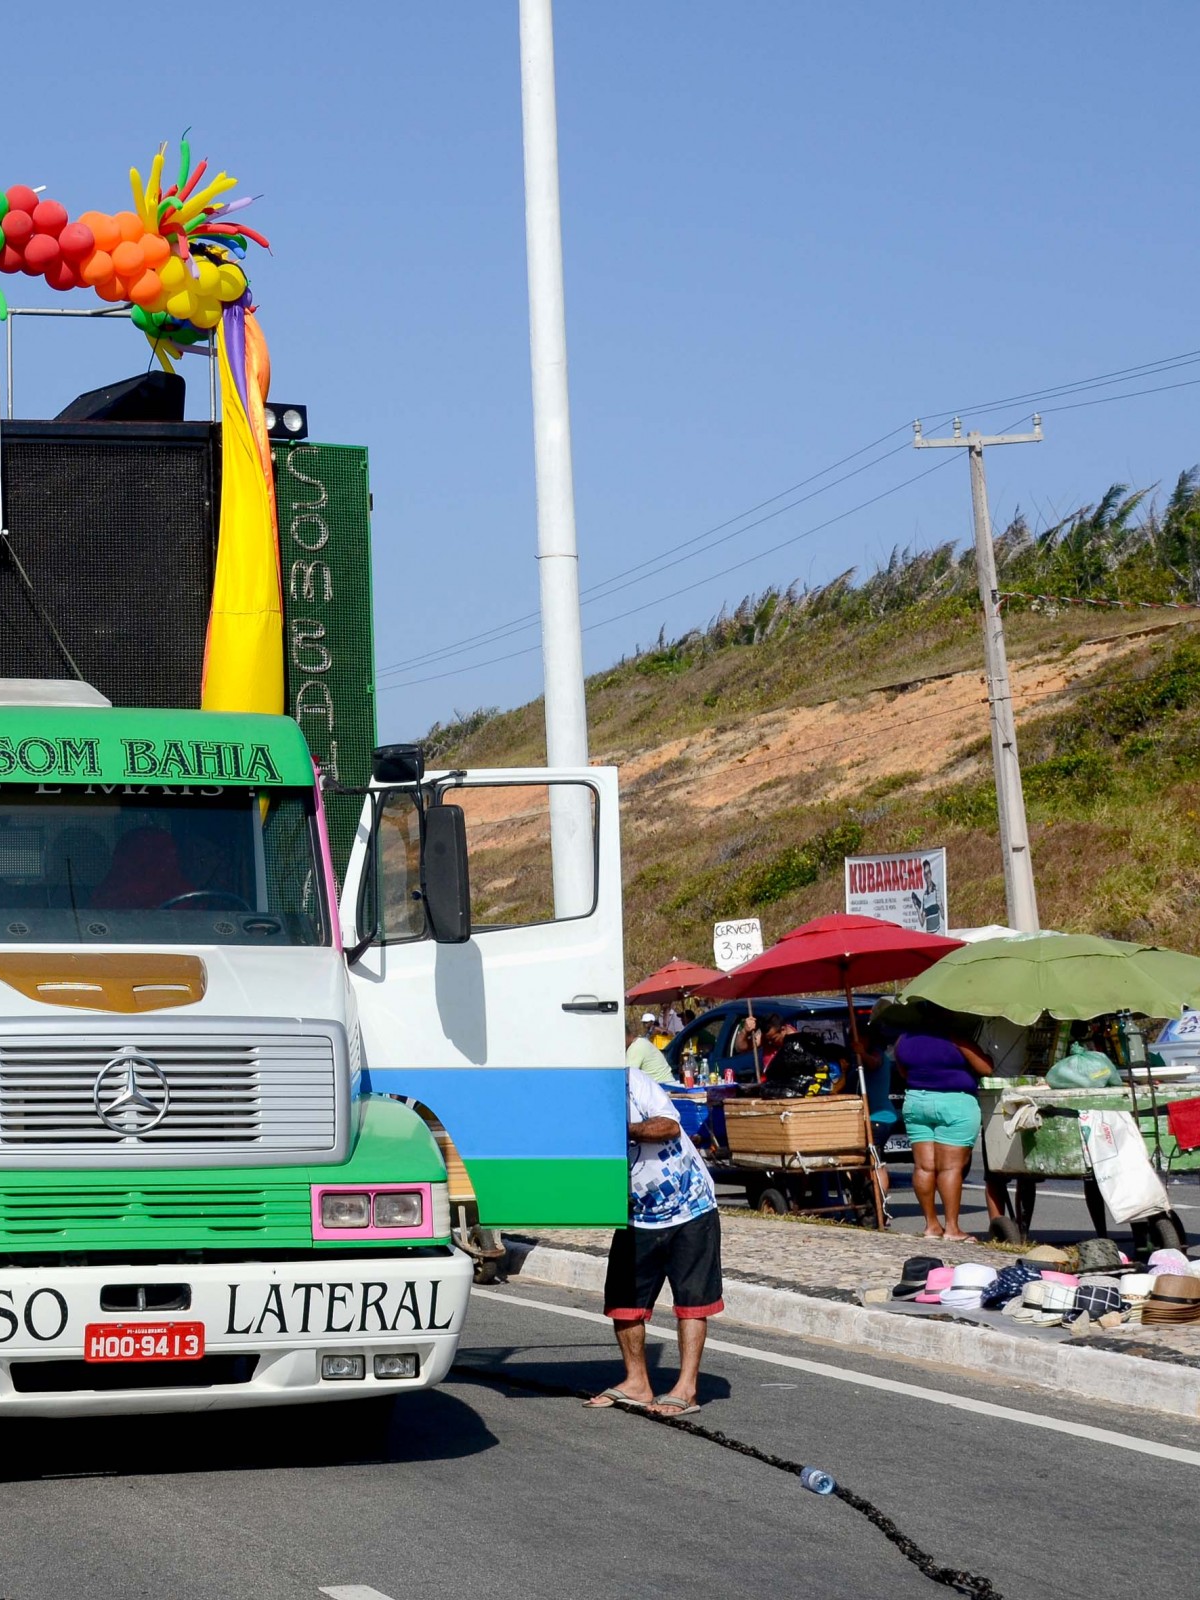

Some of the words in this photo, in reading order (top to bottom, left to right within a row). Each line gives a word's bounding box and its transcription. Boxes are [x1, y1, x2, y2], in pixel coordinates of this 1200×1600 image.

[286, 446, 333, 602] SOM
[120, 738, 284, 783] BAHIA
[849, 858, 924, 894] KUBANACAN
[715, 922, 759, 937] CERVEJA
[720, 941, 733, 960] 3
[736, 942, 752, 951] POR
[223, 1280, 455, 1335] LATERAL
